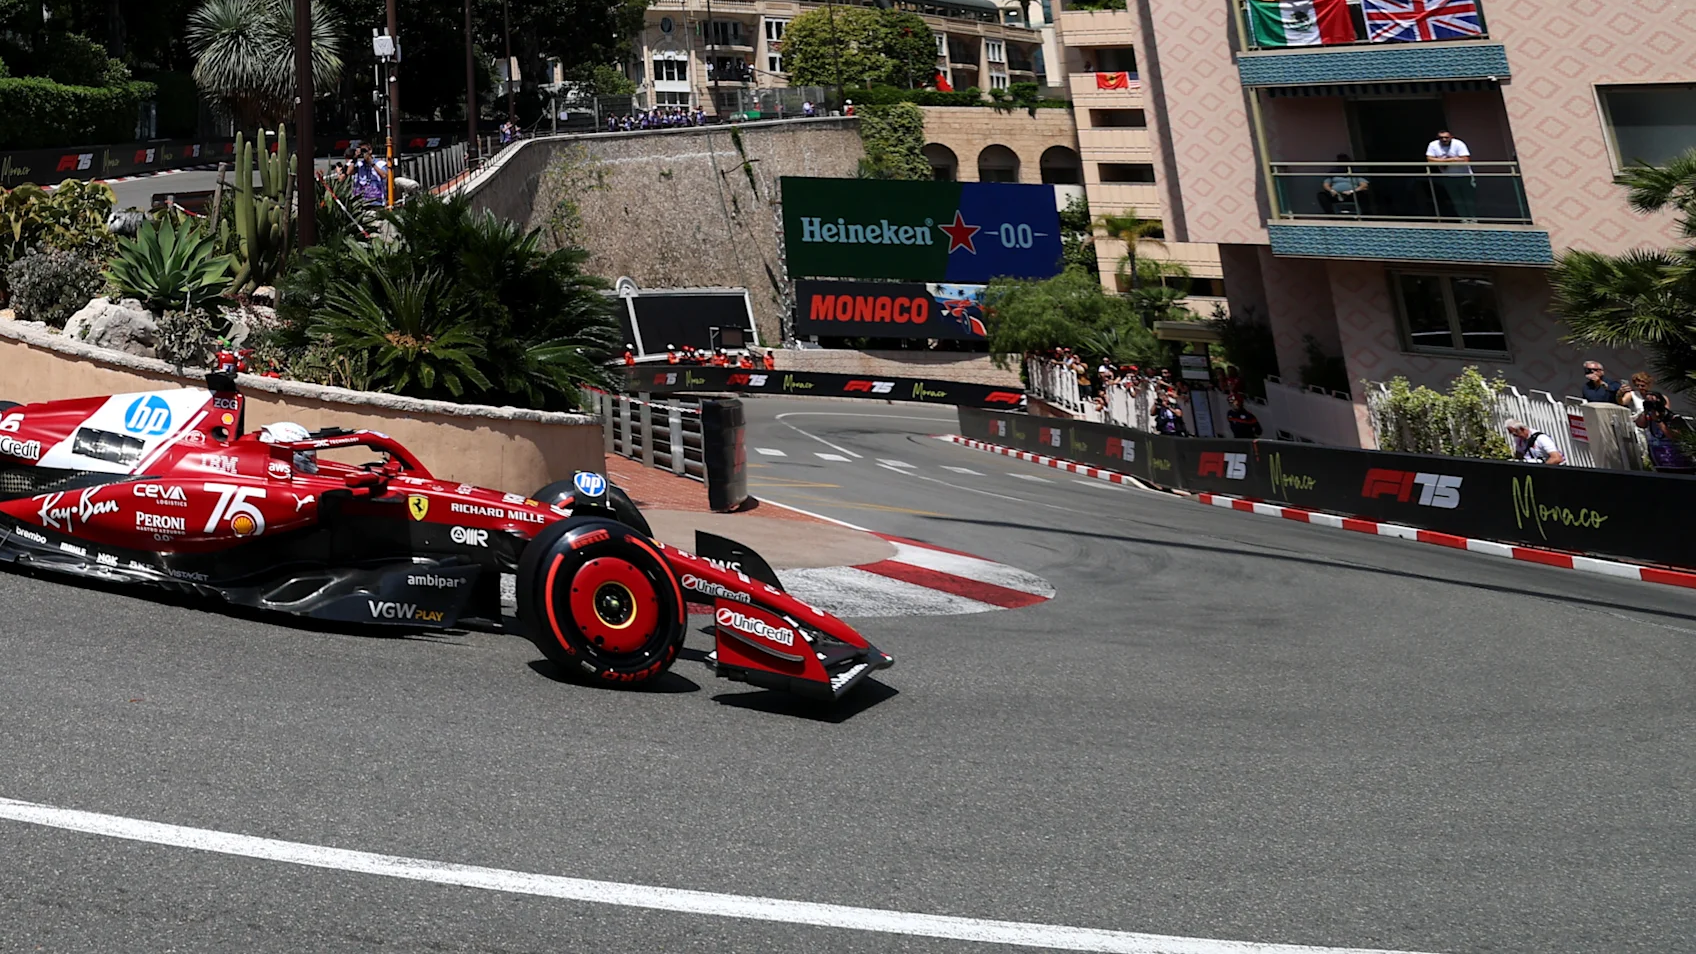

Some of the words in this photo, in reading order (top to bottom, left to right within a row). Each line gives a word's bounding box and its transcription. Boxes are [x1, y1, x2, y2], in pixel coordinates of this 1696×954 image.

[77, 153, 94, 170] 75
[800, 217, 934, 246] Heineken
[1000, 223, 1033, 249] 0.0
[809, 294, 929, 324] MONACO
[748, 374, 768, 386] 75
[871, 382, 896, 393] 75
[912, 382, 947, 400] Monaco
[213, 397, 238, 410] ZCG
[126, 395, 171, 435] hp
[268, 462, 291, 474] aws
[1223, 453, 1247, 480] 75
[1269, 452, 1316, 501] Monaco
[578, 472, 604, 496] hp
[156, 499, 188, 507] LOGISTICS
[203, 483, 267, 536] 75
[450, 502, 504, 518] RICHARD
[507, 510, 545, 524] MILLE
[1413, 472, 1463, 509] 75
[1512, 475, 1608, 540] Monaco
[135, 511, 185, 531] PERONI
[15, 525, 47, 545] brembo
[60, 542, 87, 557] MAHLE
[97, 552, 119, 566] NGK
[407, 574, 459, 589] ambipar
[696, 578, 751, 604] UniCredit
[415, 609, 444, 622] PLAY
[732, 612, 794, 646] UniCredit
